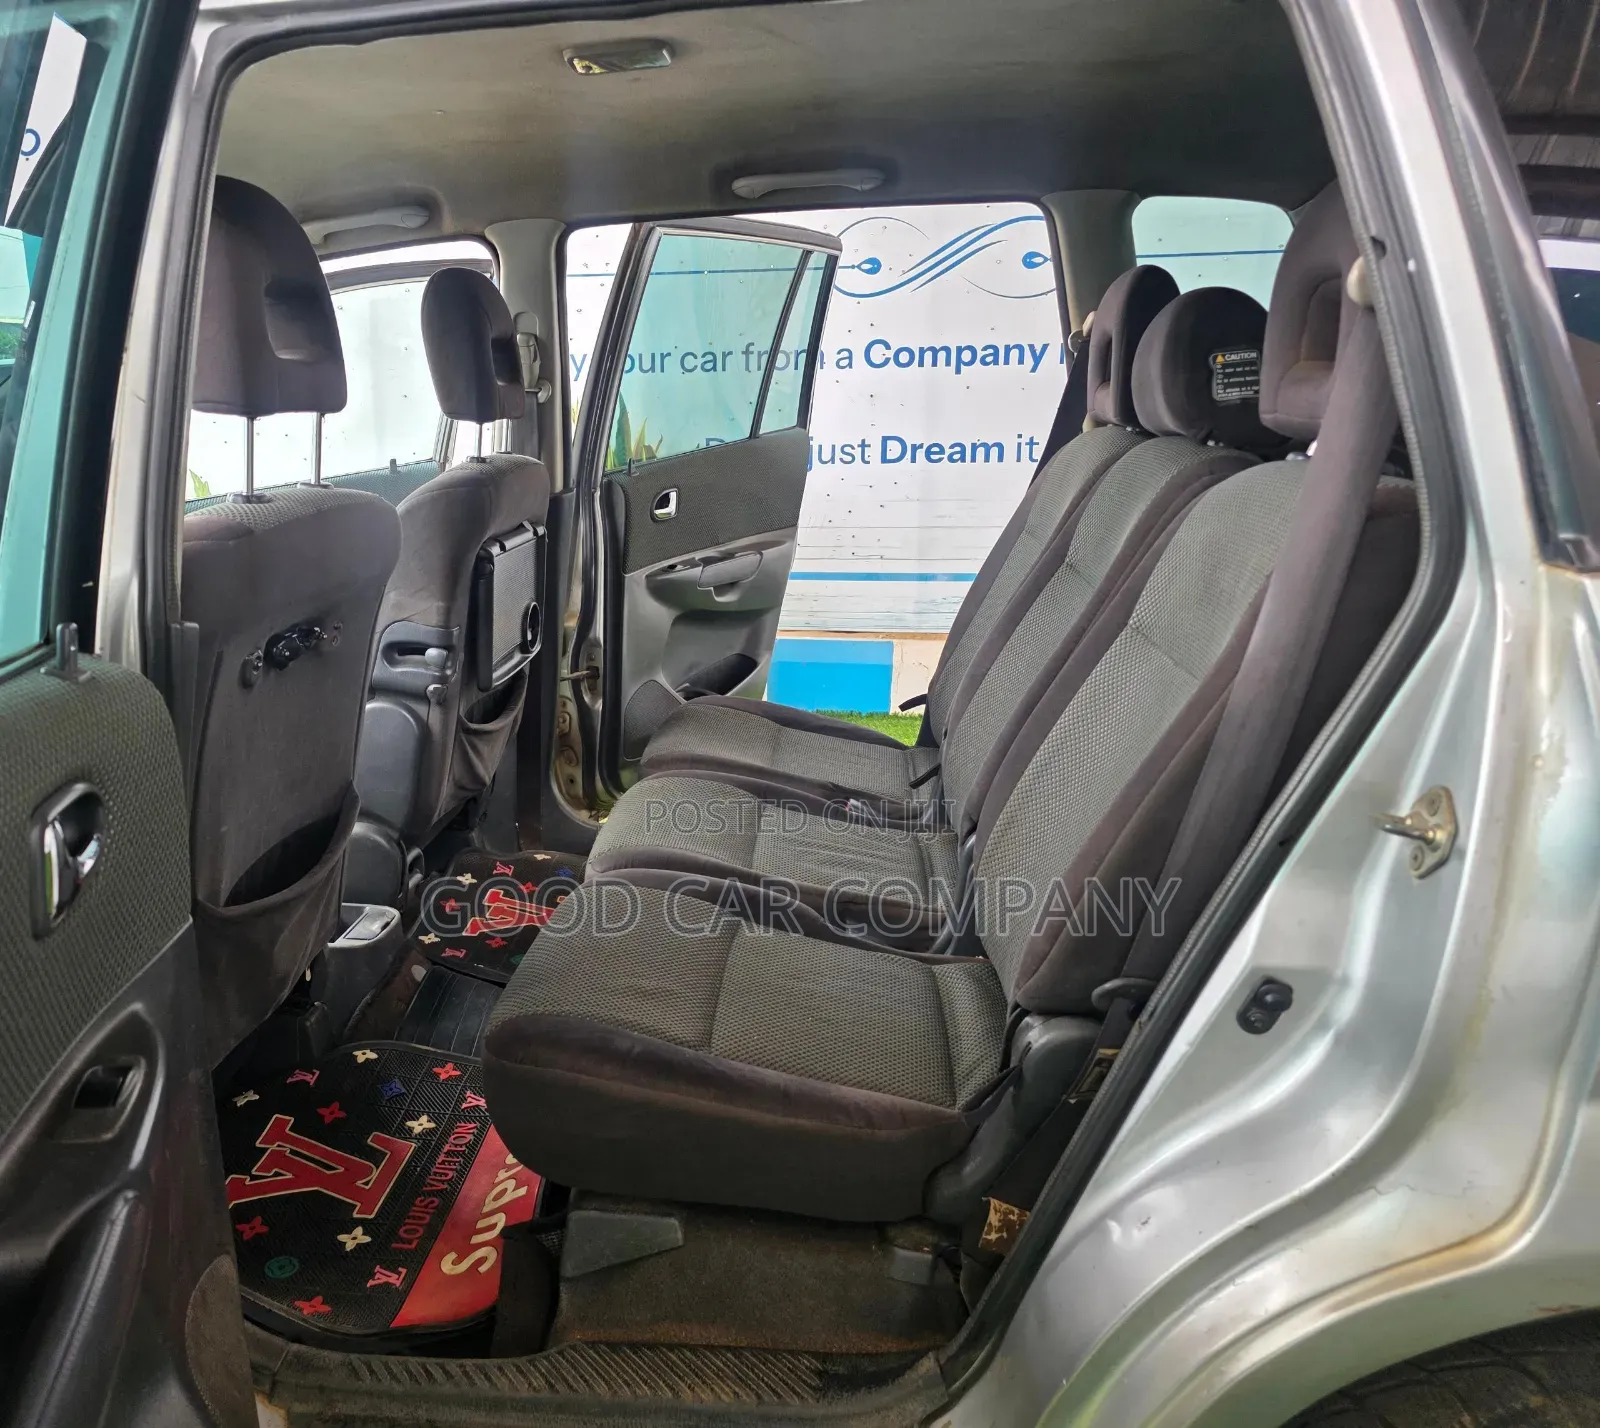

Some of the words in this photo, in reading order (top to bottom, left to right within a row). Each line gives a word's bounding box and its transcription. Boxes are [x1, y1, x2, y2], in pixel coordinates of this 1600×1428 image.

[679, 349, 734, 374] car
[741, 342, 826, 374] from
[834, 347, 854, 370] a
[863, 338, 1051, 375] Company
[1224, 352, 1257, 361] CAUTION
[806, 435, 872, 472] just
[880, 435, 1005, 464] Dream
[391, 1196, 440, 1250] LOUIS
[422, 1122, 479, 1192] VUITTON
